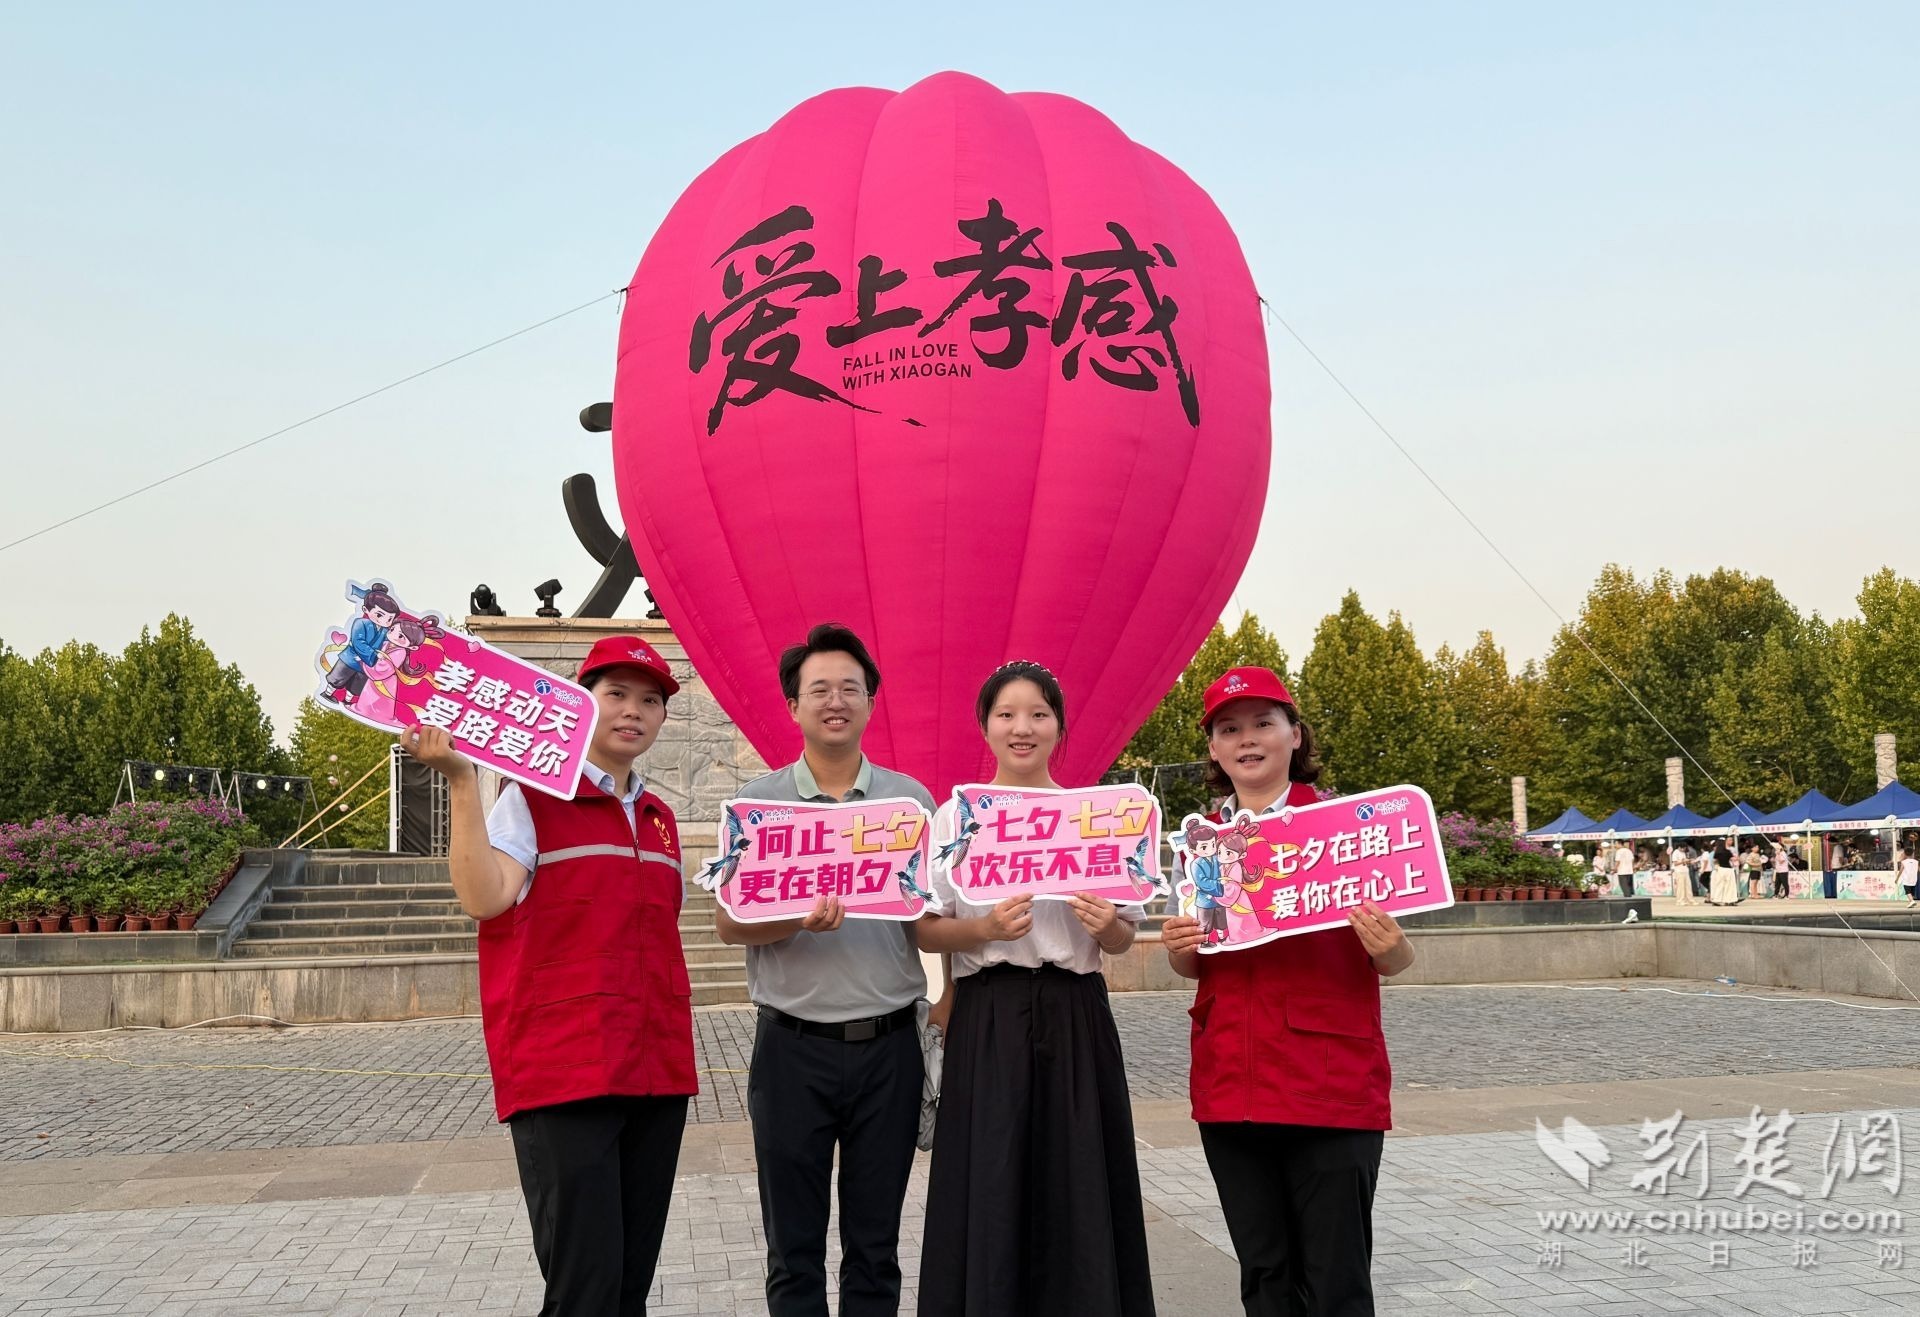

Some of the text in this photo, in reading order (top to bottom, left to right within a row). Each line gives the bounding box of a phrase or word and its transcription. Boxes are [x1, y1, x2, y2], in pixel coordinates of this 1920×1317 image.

[689, 197, 1200, 436] 爱上孝感
[842, 362, 972, 391] WITH XIAOGAN
[843, 343, 959, 371] FALL IN LOVE
[433, 659, 580, 742] 孝感动天
[416, 692, 571, 778] 爱路爱你
[968, 844, 1122, 889] 欢乐不息
[1269, 817, 1424, 874] 七夕在路上
[738, 857, 894, 907] 更在朝夕
[1271, 863, 1428, 920] 爱你在心上
